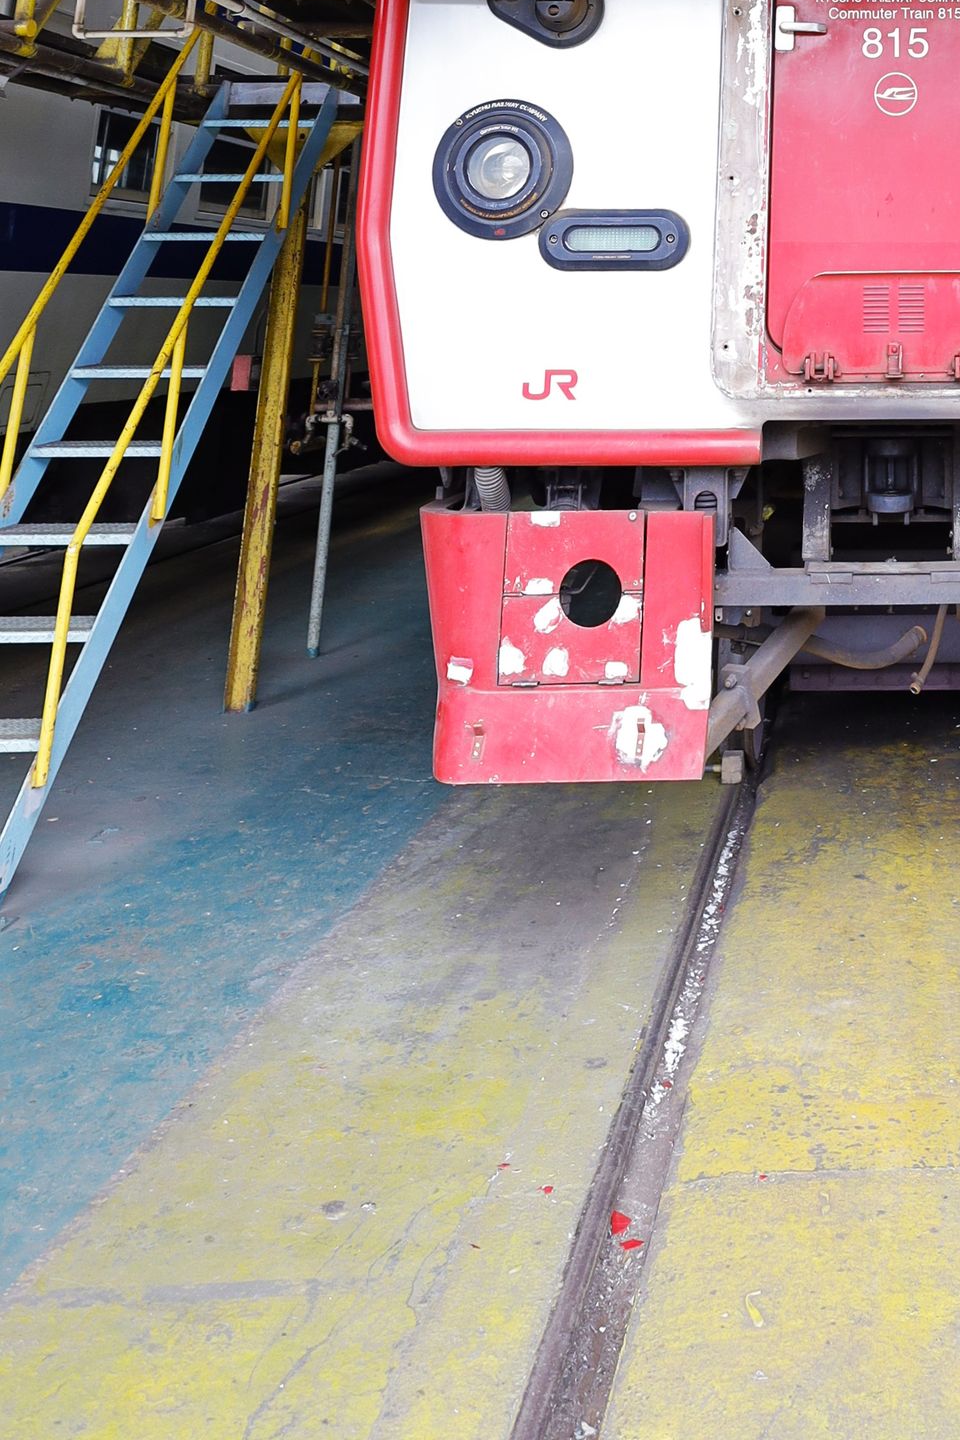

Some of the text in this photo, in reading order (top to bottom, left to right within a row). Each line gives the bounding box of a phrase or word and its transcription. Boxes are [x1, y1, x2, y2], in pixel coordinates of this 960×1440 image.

[828, 7, 897, 19] Commuter
[901, 7, 934, 19] Train
[861, 27, 929, 59] 815
[522, 369, 578, 401] JR
